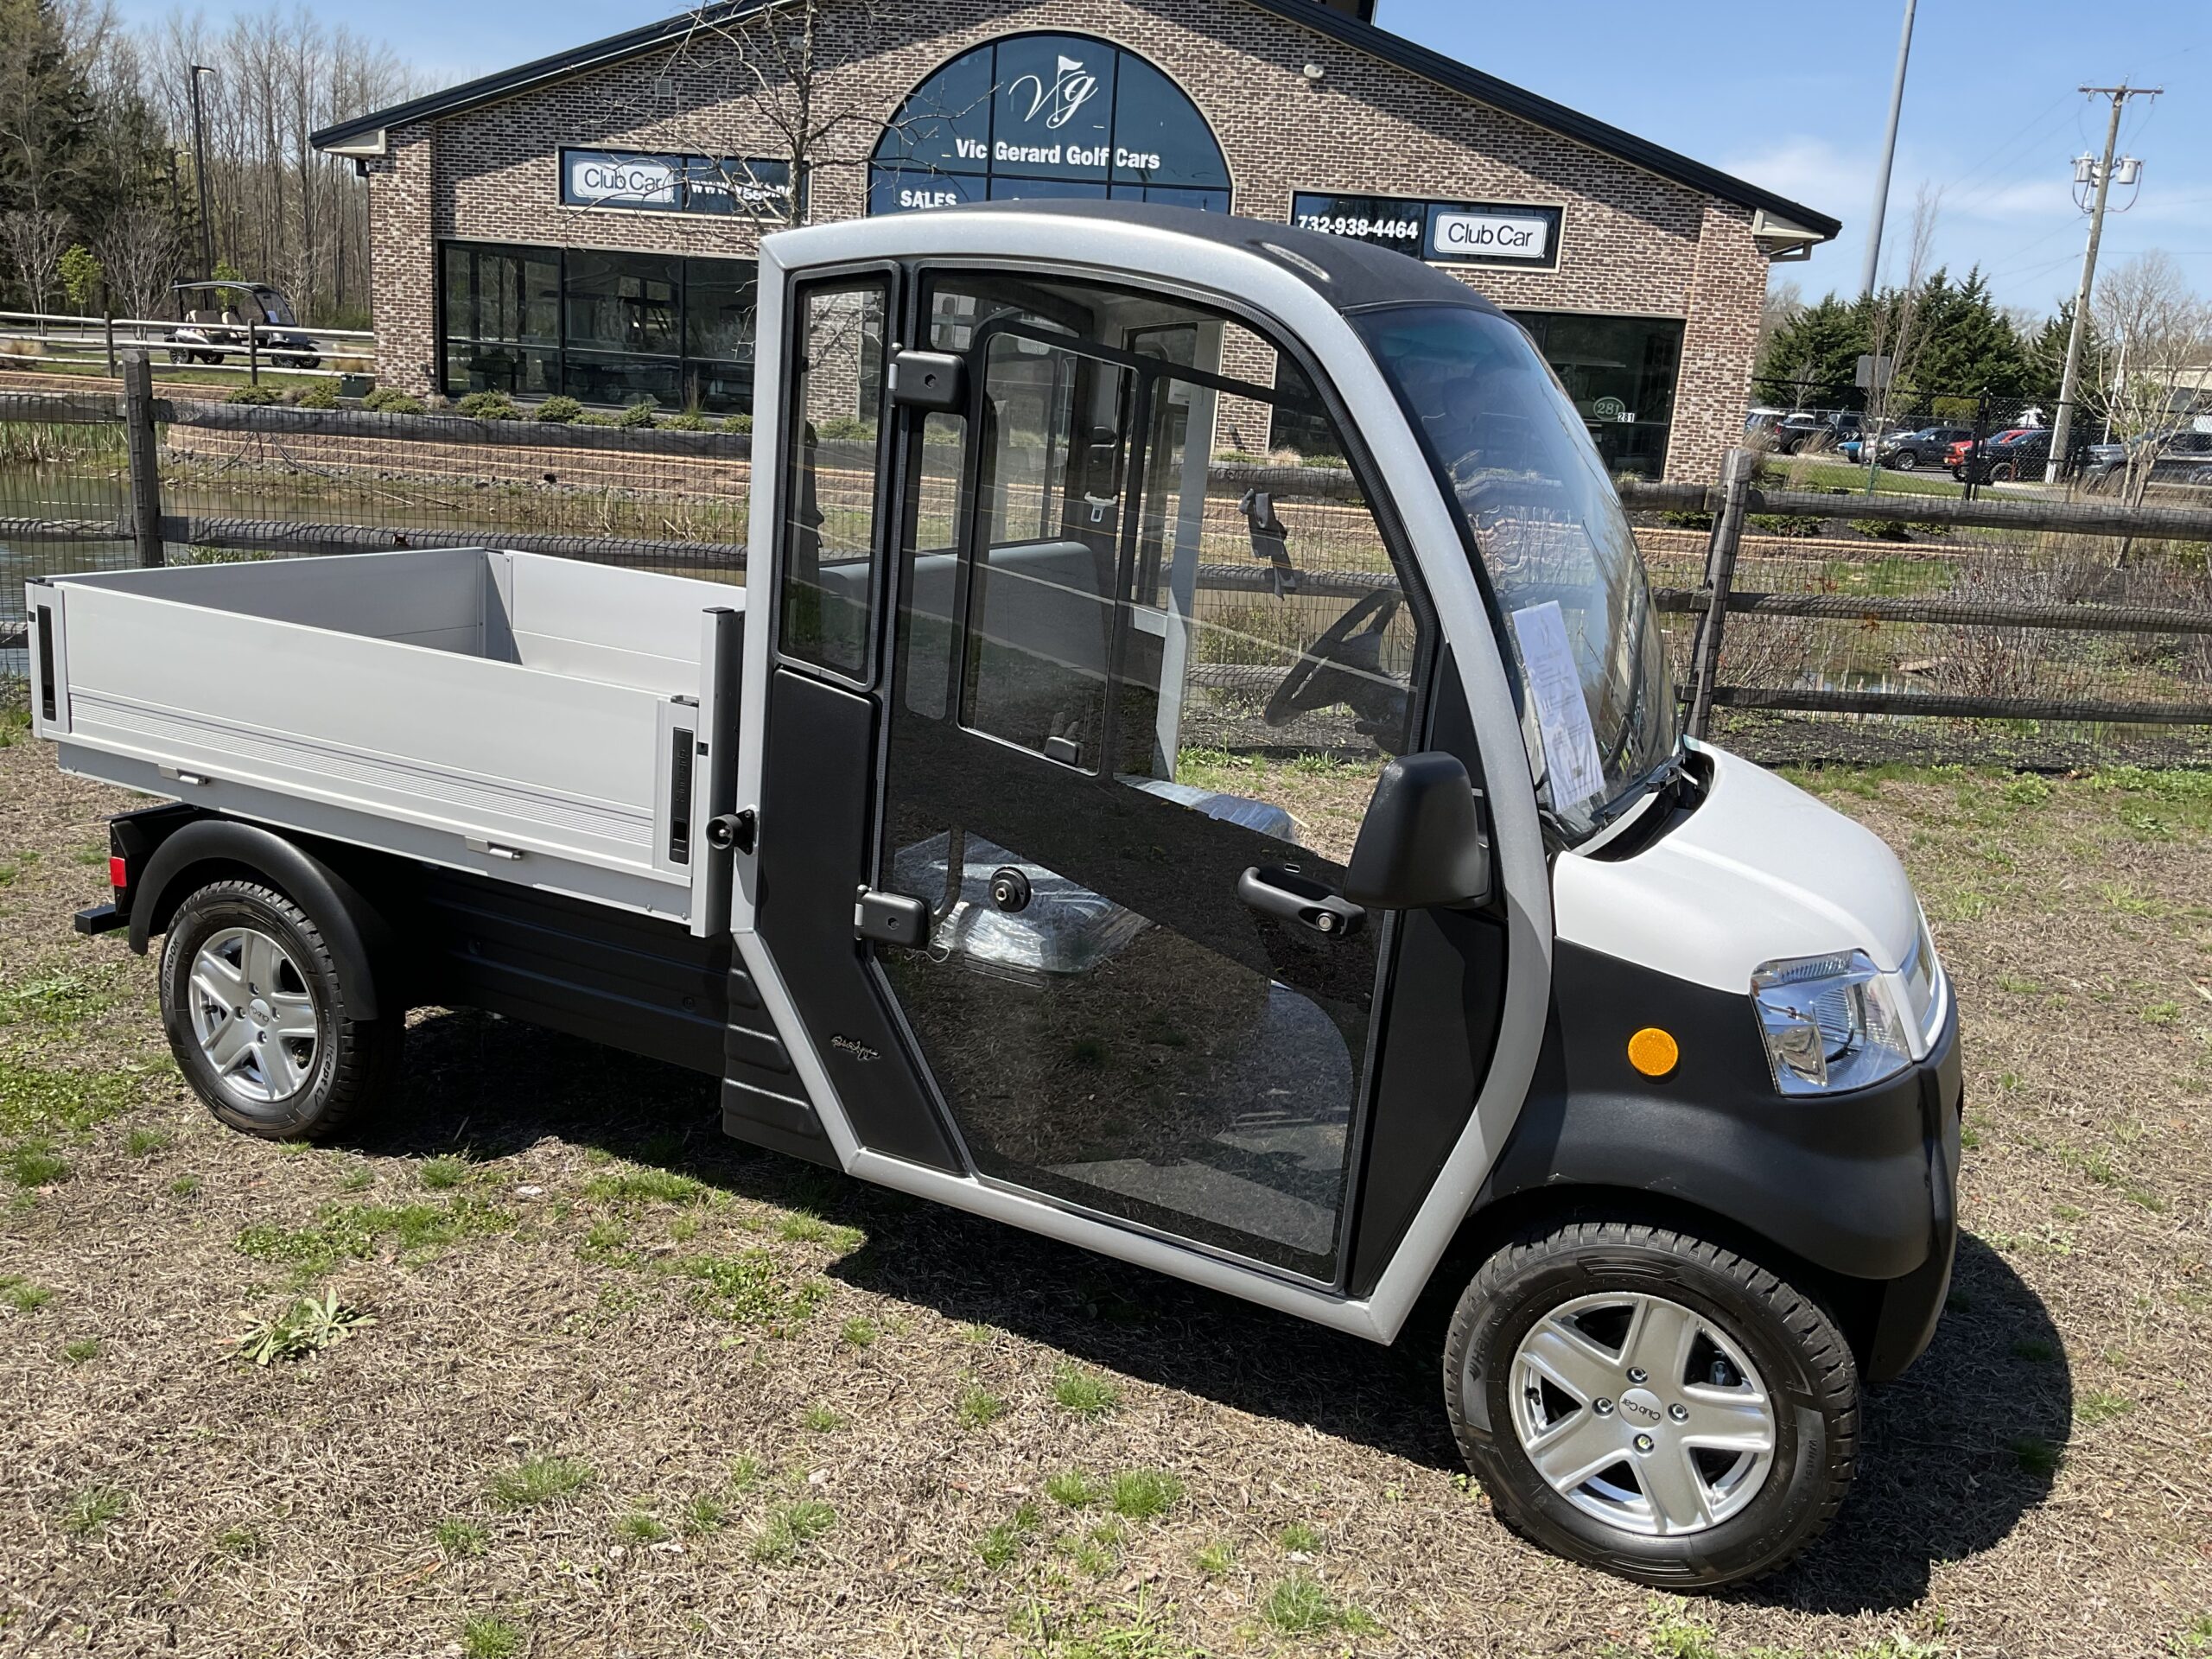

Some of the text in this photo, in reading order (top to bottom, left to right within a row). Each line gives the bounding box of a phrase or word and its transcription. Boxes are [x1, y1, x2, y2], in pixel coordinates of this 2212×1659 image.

[957, 139, 1160, 169] Vic Gerard Golf Cars
[584, 168, 663, 192] Club Car
[899, 190, 957, 208] SALES
[1298, 215, 1419, 239] 732-938-4464
[1448, 222, 1534, 247] Club Car
[1597, 403, 1620, 416] 281
[1618, 413, 1634, 422] 281
[1621, 1398, 1661, 1421] Club Car
